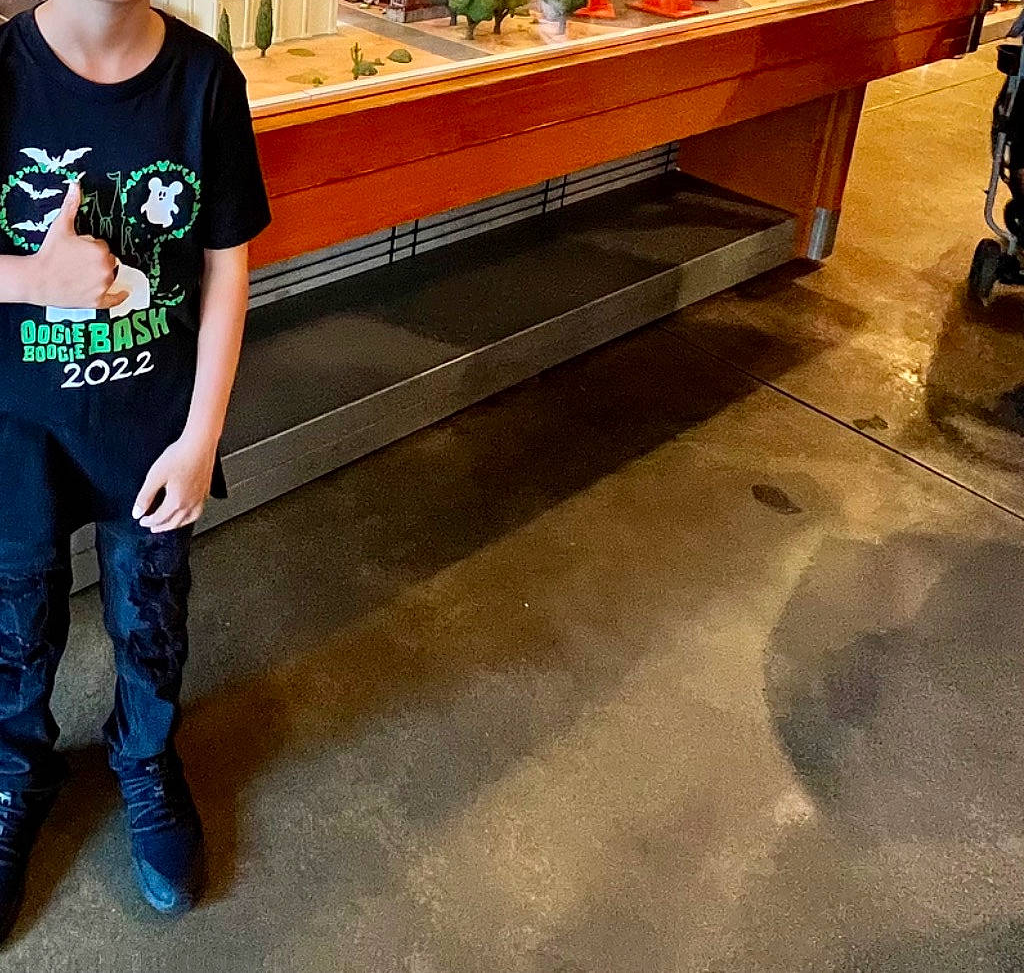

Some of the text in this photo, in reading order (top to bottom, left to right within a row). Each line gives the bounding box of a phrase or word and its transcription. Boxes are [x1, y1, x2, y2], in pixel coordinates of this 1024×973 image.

[20, 307, 171, 356] OOGIE BASH
[22, 344, 86, 363] BOOGIE
[60, 350, 155, 389] 2022
